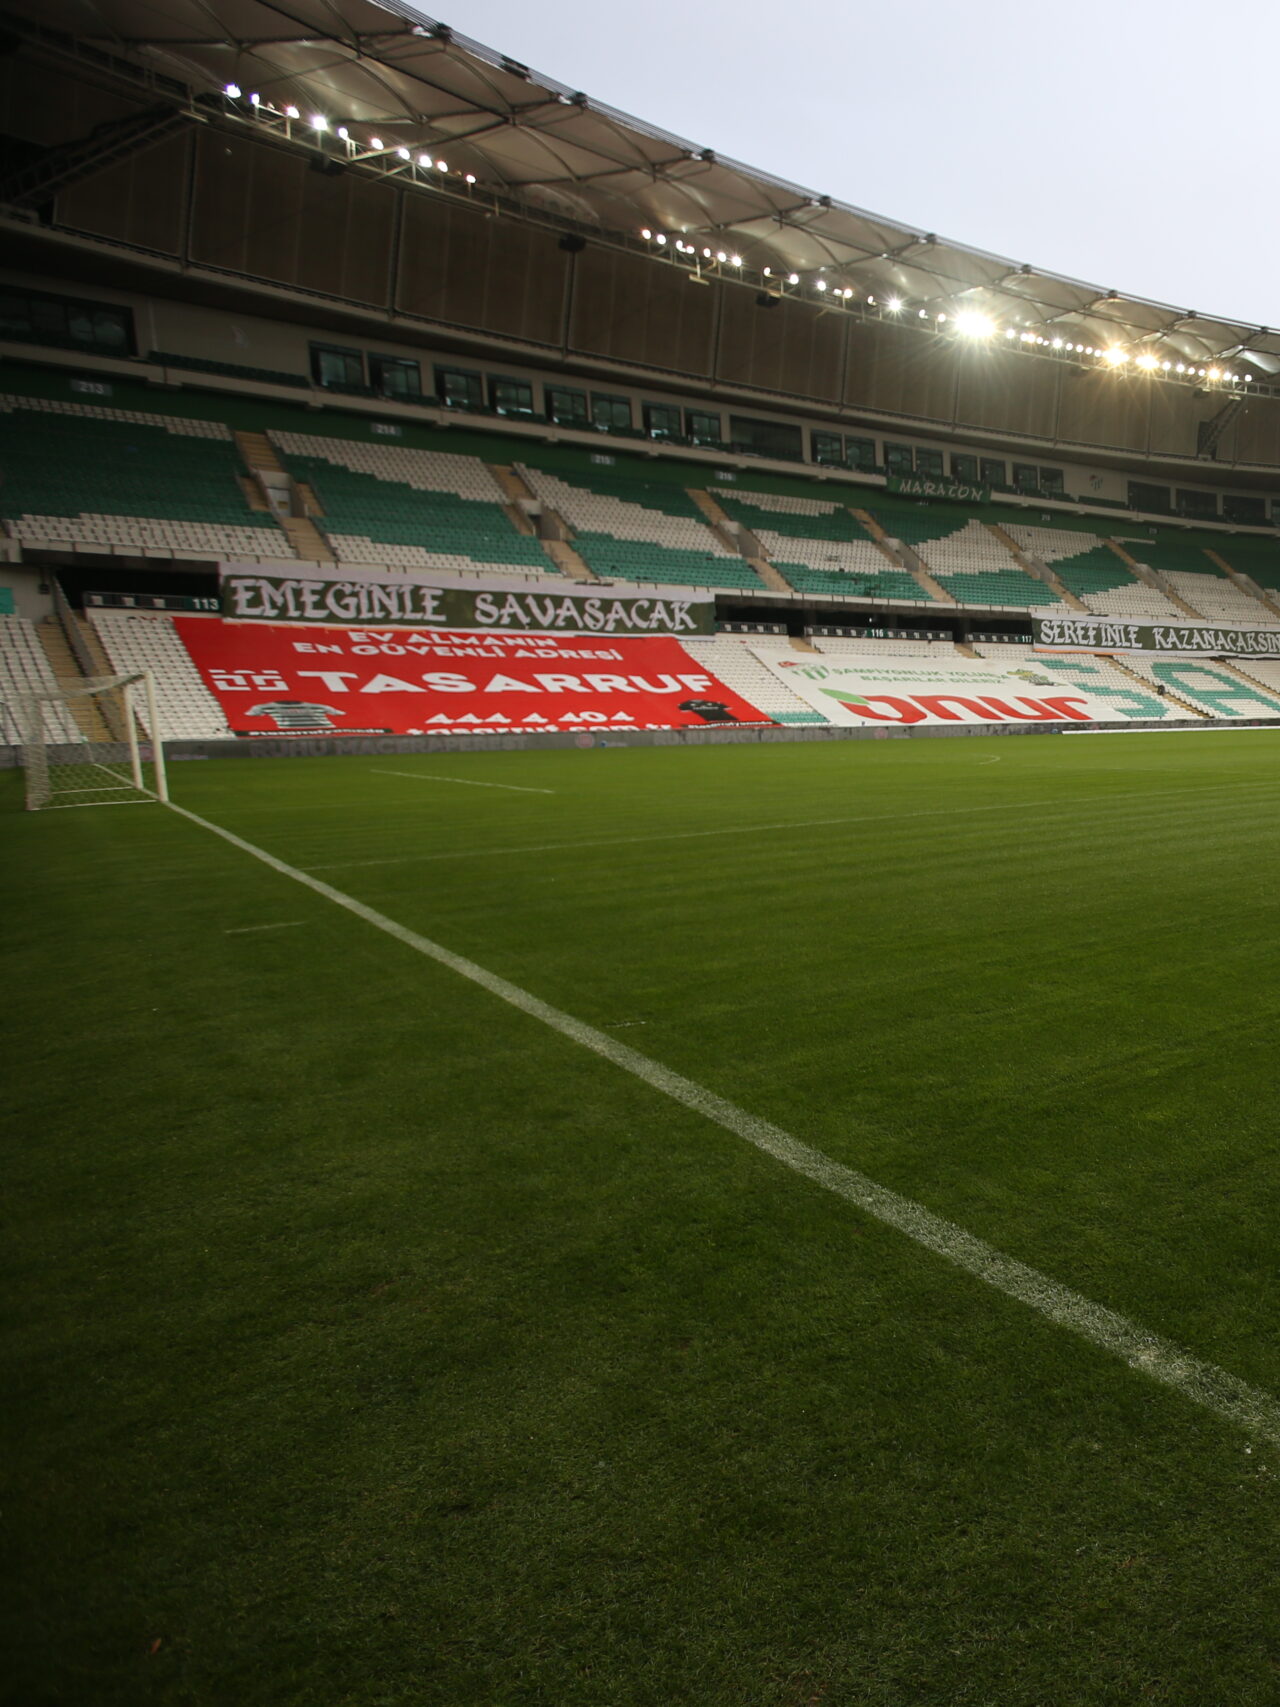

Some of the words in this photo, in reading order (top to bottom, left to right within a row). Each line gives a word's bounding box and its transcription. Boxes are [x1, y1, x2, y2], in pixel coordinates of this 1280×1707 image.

[191, 598, 220, 611] 113
[348, 631, 394, 642] EV
[407, 633, 559, 647] ALMANIN
[871, 628, 885, 638] 116
[292, 643, 345, 655] EN
[513, 649, 624, 661] ADRESİ
[296, 671, 714, 694] TASARRUF
[424, 712, 513, 724] 444
[521, 712, 549, 724] 4
[558, 710, 636, 723] 404
